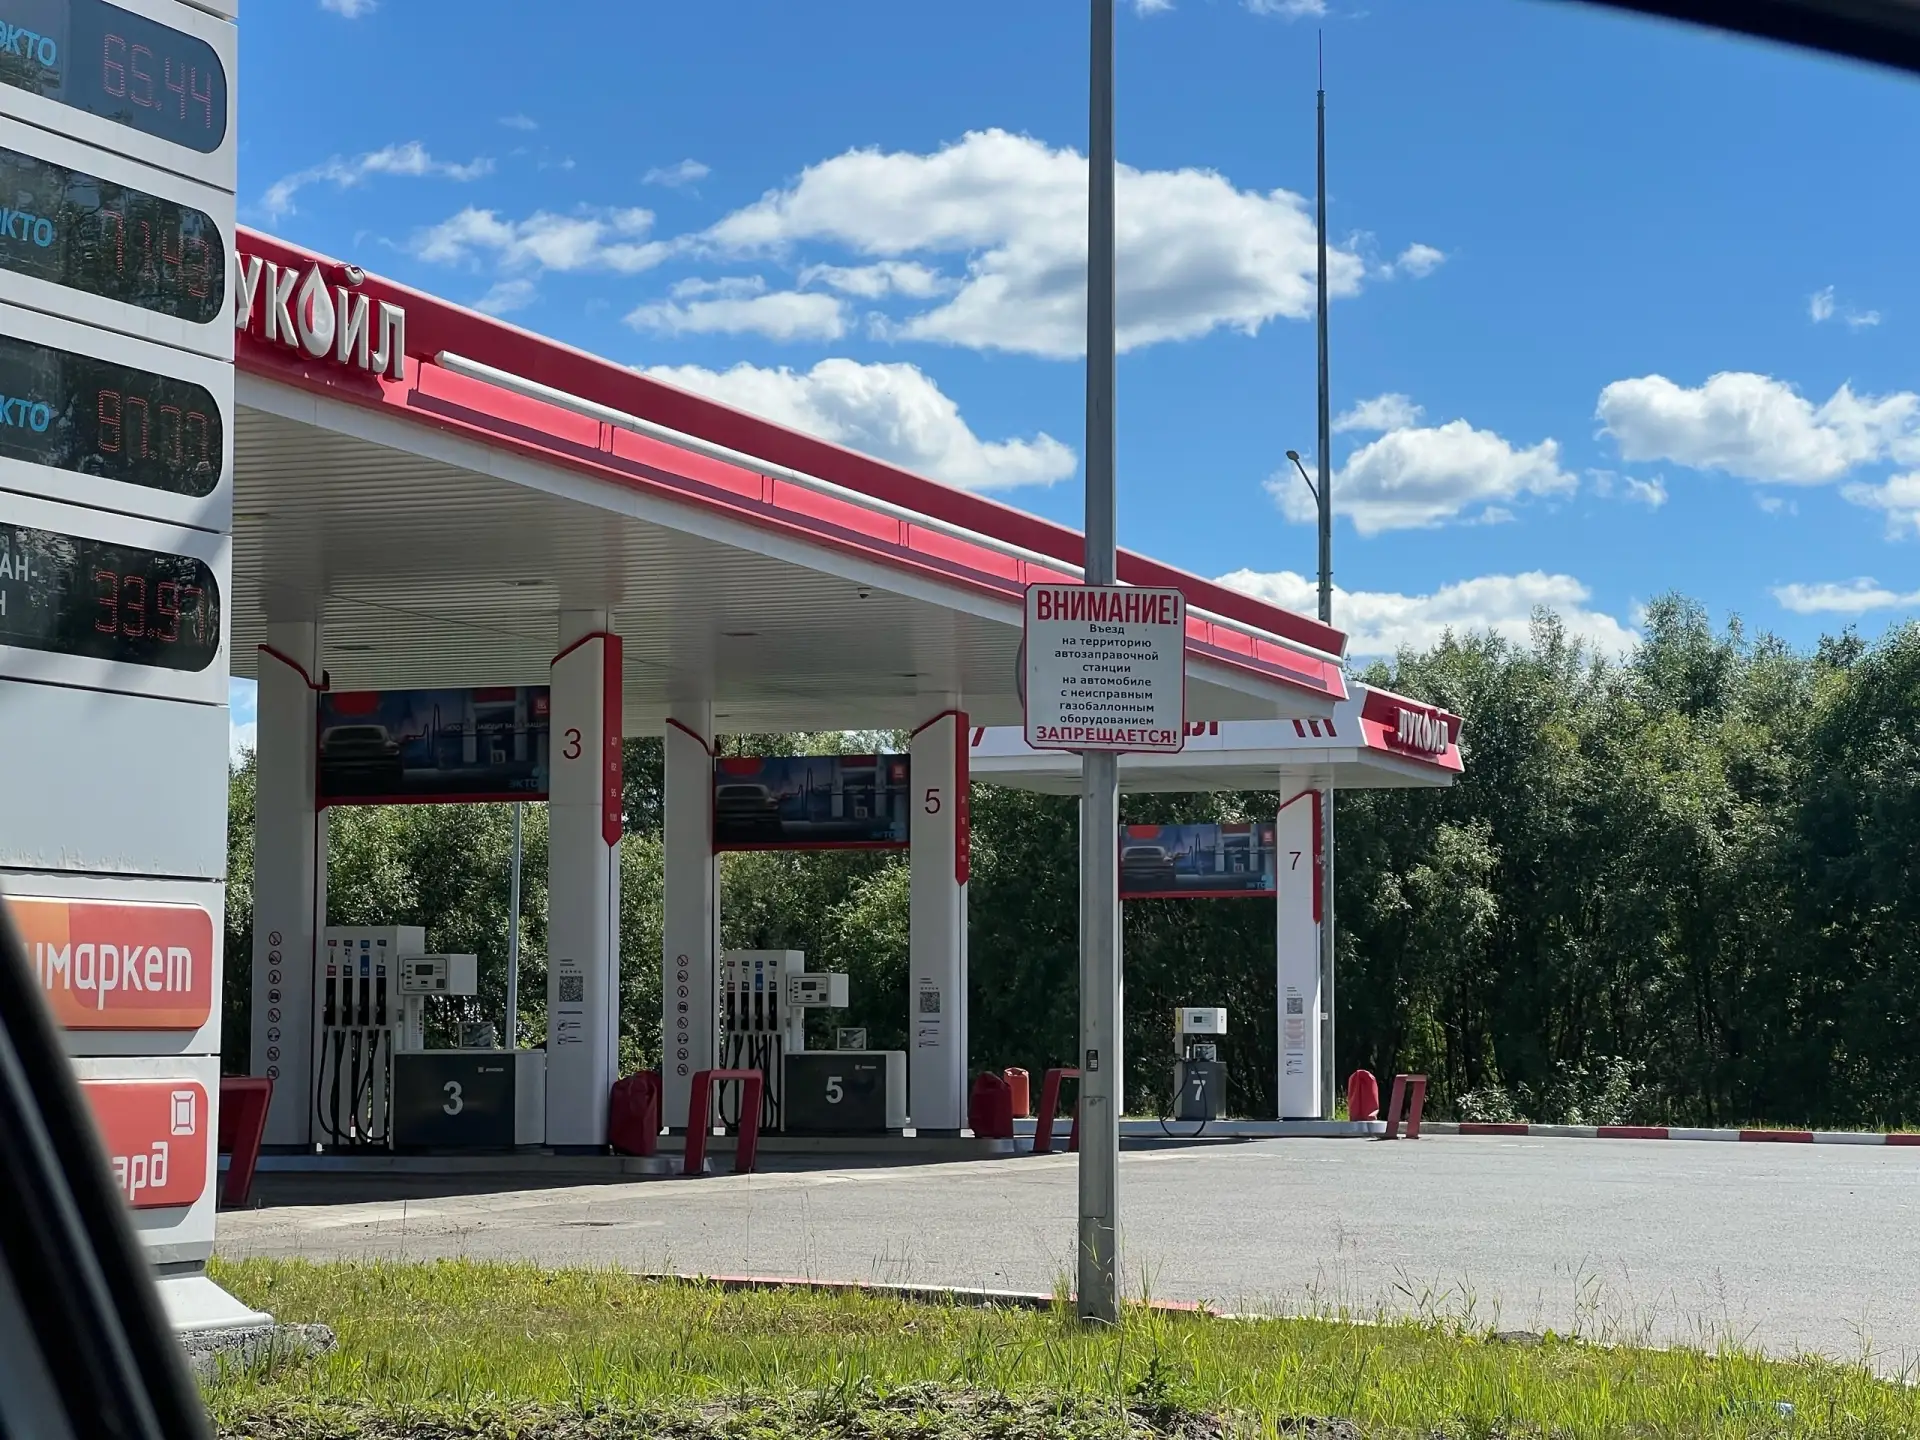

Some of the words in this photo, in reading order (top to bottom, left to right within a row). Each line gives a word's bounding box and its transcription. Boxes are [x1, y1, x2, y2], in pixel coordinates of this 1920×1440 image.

[103, 33, 212, 129] 65.44
[0, 208, 53, 247] КТО
[98, 389, 208, 466] 97.77
[95, 569, 206, 645] 33.97
[1037, 590, 1179, 625] ВНИМАНИЕ!
[1089, 624, 1125, 635] Въезд
[1080, 638, 1152, 648] территорию
[1054, 650, 1159, 661] автозаправочной
[1082, 664, 1131, 673] станции
[1080, 677, 1152, 686] автомобиле
[1071, 690, 1153, 700] неисправным
[1059, 702, 1154, 712] газобаллонным
[1060, 714, 1154, 725] оборудованием
[1397, 707, 1449, 754] ЛУКОЙЛ
[562, 728, 582, 760] 3
[1036, 726, 1177, 744] ЗАПРЕЩАЕТСЯ!
[924, 788, 941, 814] 5
[1288, 851, 1302, 871] 7
[442, 1081, 464, 1116] 3
[825, 1076, 844, 1104] 5
[1192, 1079, 1206, 1101] 7
